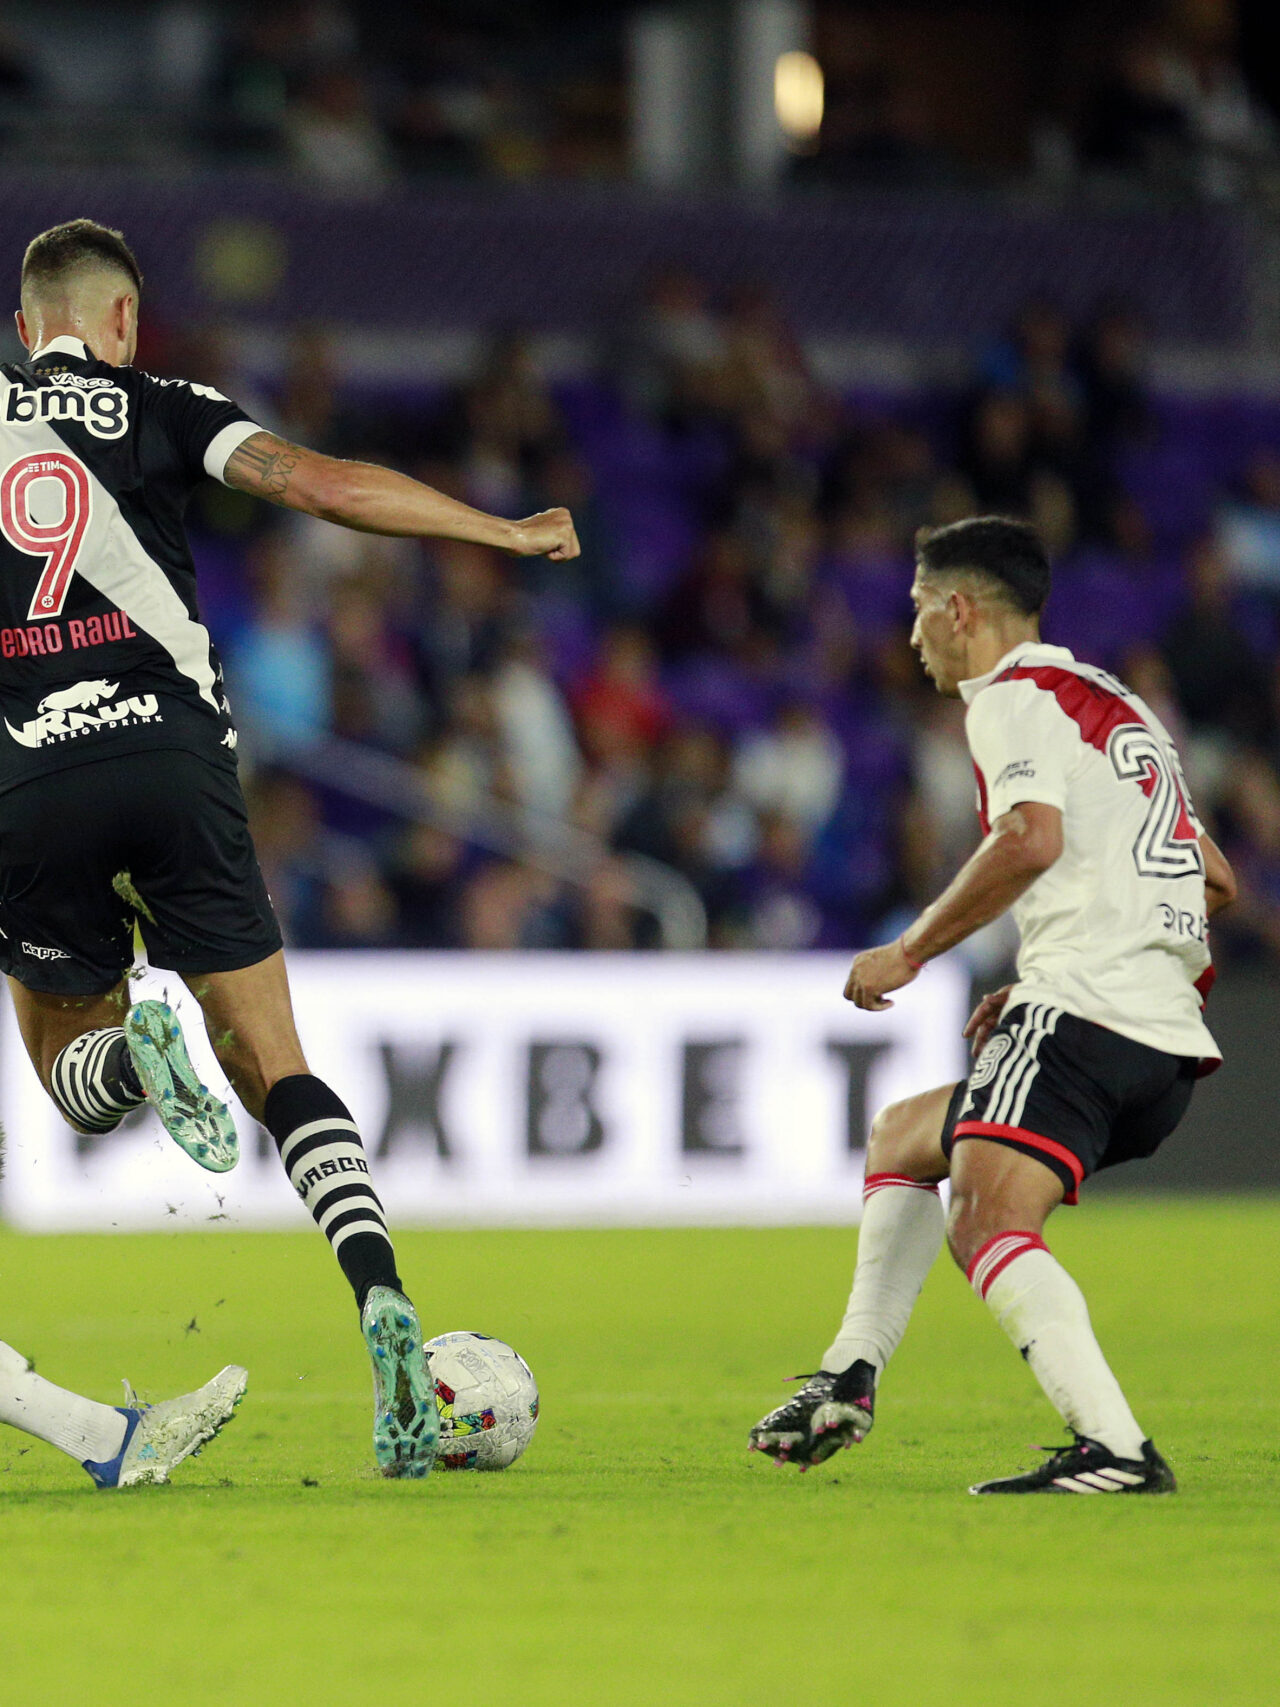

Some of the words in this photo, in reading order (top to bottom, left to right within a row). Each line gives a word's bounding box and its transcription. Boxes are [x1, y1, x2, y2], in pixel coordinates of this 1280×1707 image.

[49, 373, 114, 389] VASCO
[6, 385, 126, 437] bmg
[40, 461, 61, 472] TIM
[295, 1156, 370, 1199] VASCO
